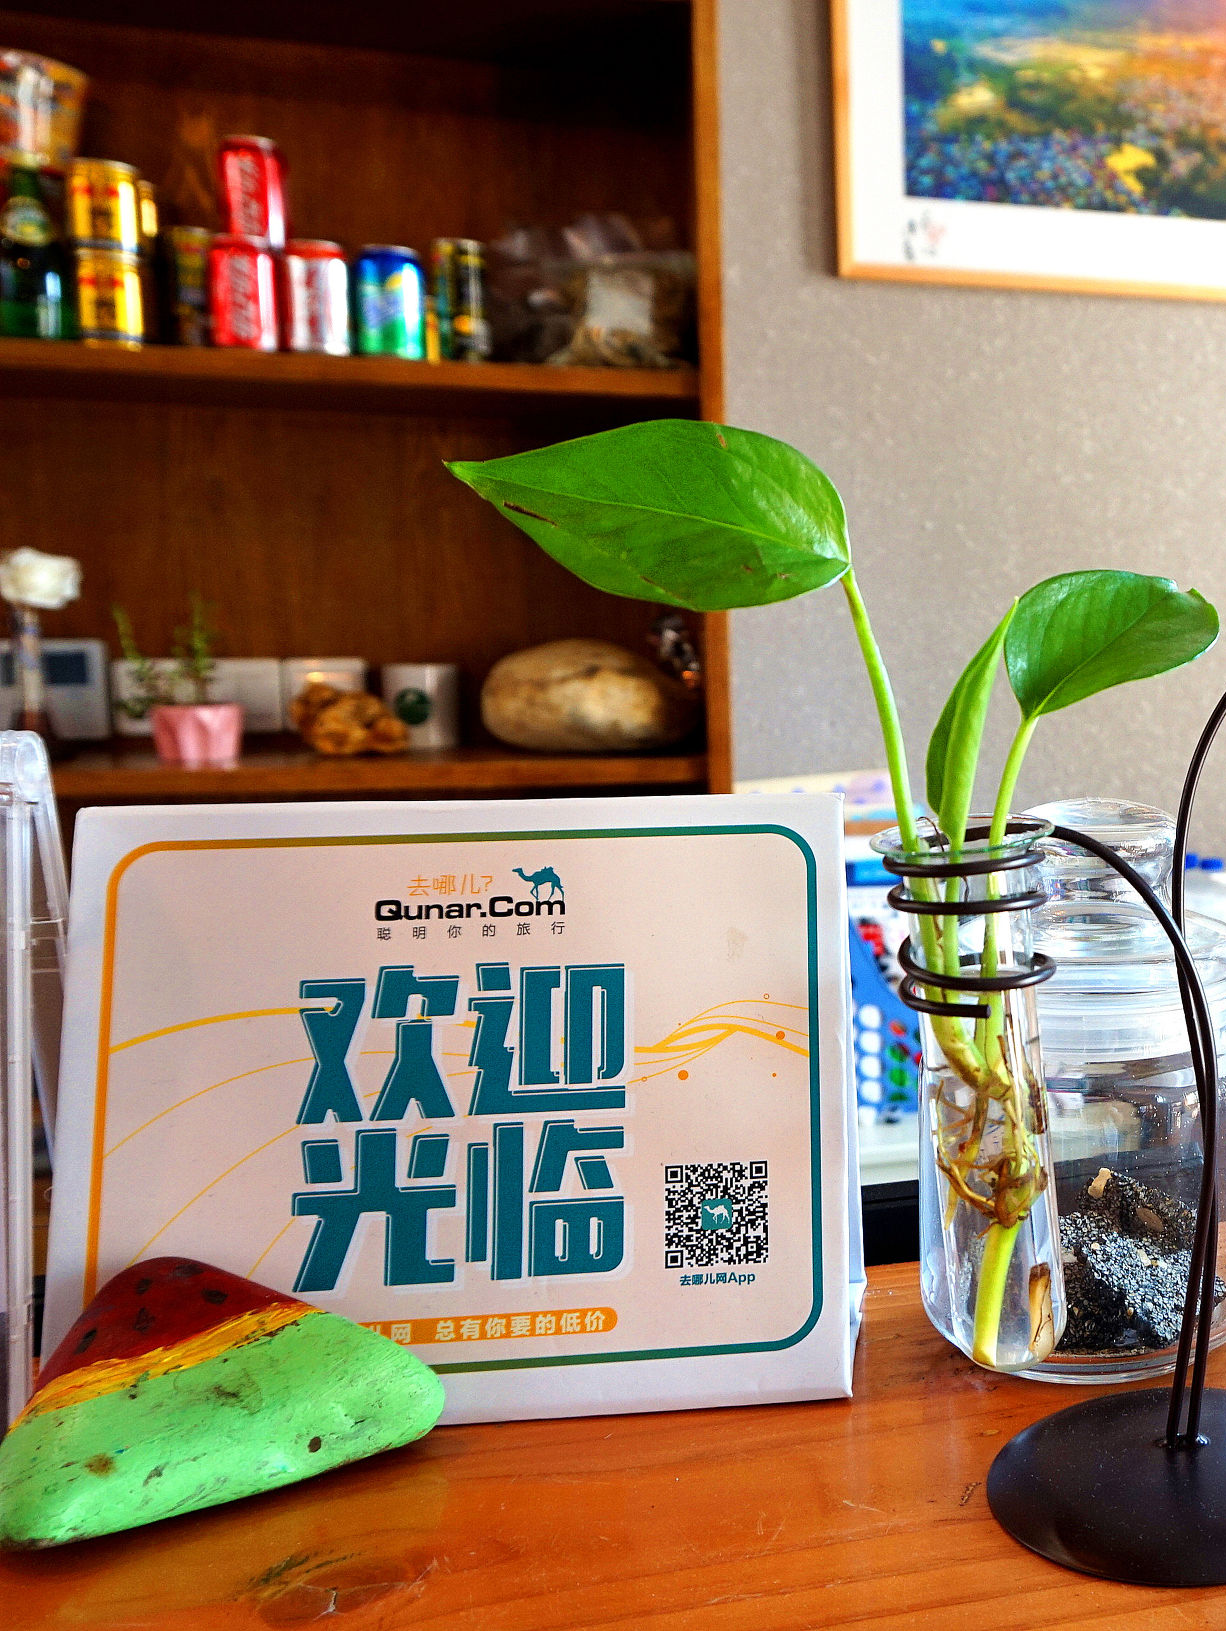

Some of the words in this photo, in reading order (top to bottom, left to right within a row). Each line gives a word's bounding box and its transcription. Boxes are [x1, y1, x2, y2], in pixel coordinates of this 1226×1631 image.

[375, 896, 566, 921] Qunar.Com
[376, 921, 566, 942] 聪明你的旅行
[293, 961, 626, 1125] 欢迎
[291, 1120, 625, 1294] 光临
[680, 1272, 756, 1287] 去哪儿网App
[435, 1310, 606, 1341] 总有你要的低价
